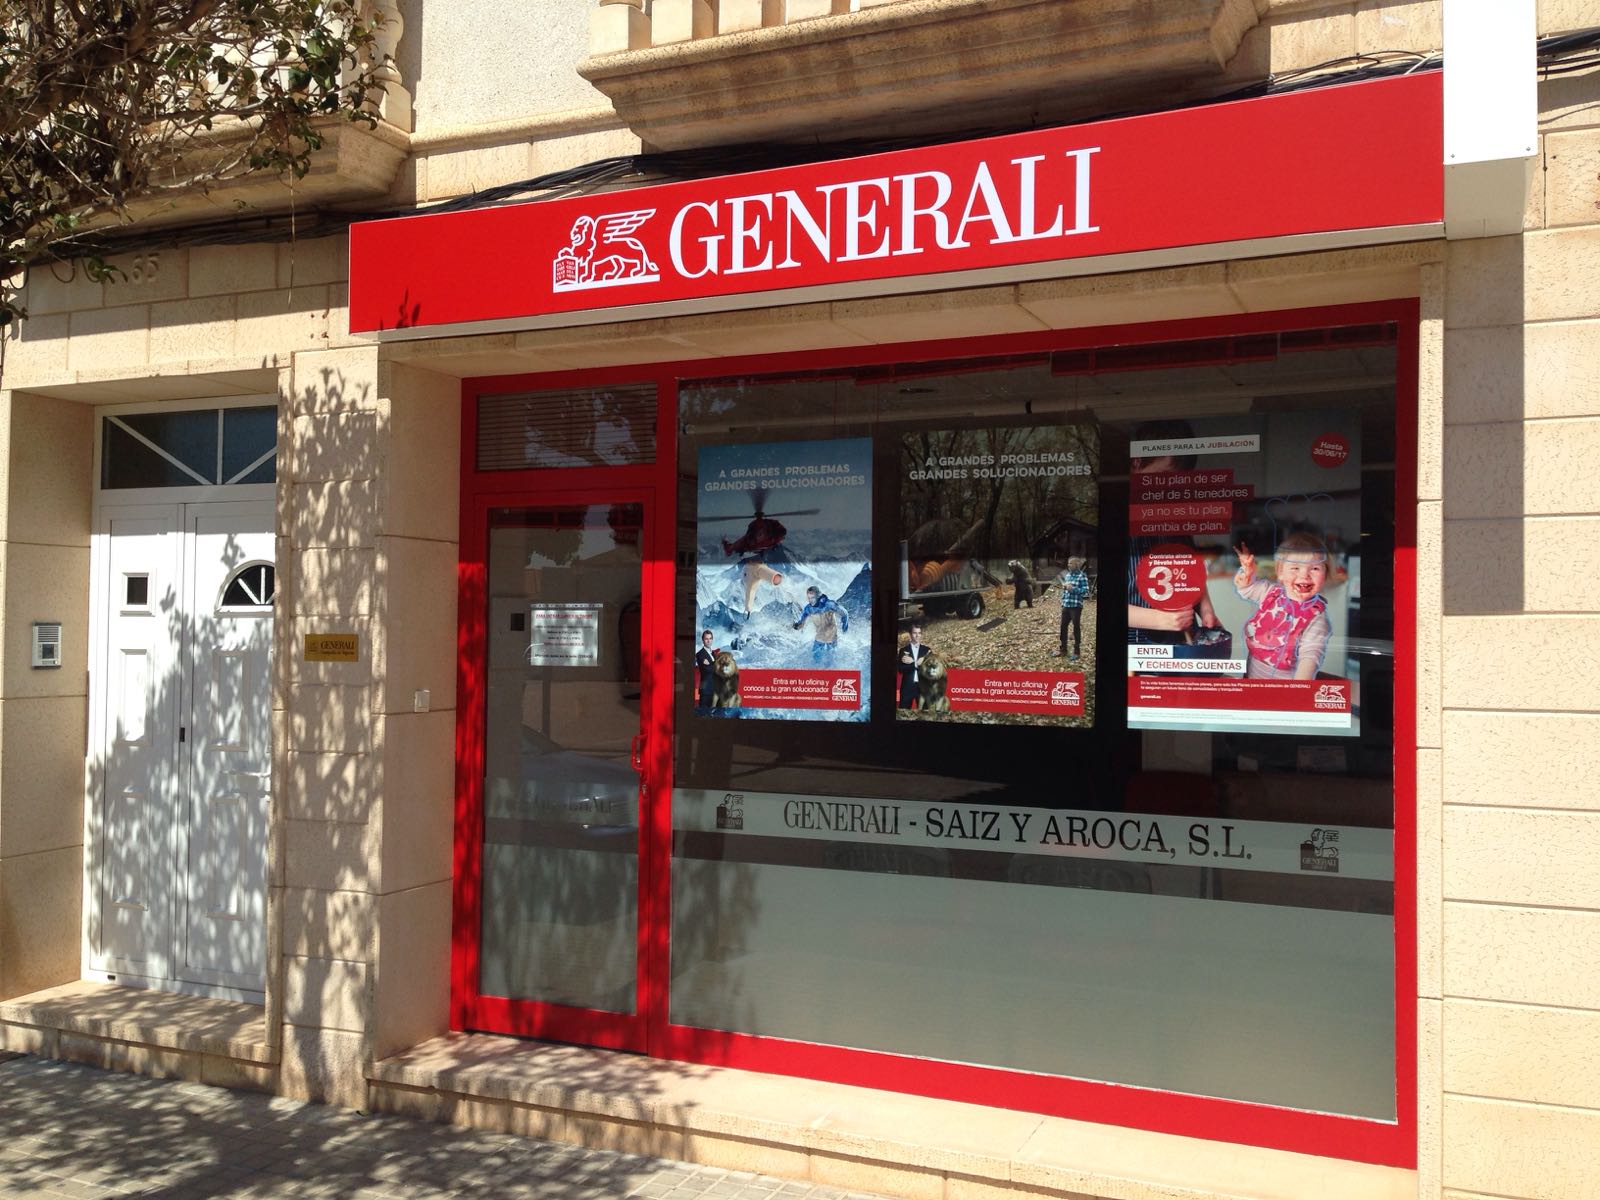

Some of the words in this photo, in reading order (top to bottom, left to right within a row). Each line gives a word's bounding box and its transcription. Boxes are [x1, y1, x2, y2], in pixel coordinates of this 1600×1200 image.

[669, 146, 1101, 278] GENERALI
[1142, 444, 1171, 452] PLANES
[1207, 440, 1255, 448] JUBILACIÓN
[1321, 441, 1343, 450] Hasta
[925, 457, 934, 466] A
[939, 455, 995, 466] GRANDES
[1001, 452, 1074, 464] PROBLEMAS
[719, 470, 726, 478] A
[730, 467, 780, 478] GRANDES
[785, 464, 850, 476] PROBLEMAS
[909, 469, 968, 480] GRANDES
[973, 465, 1091, 479] SOLUCIONADORES
[705, 480, 757, 492] GRANDES
[761, 475, 865, 489] SOLUCIONADORES
[1142, 475, 1152, 485] Si
[1155, 476, 1165, 485] tu
[1168, 474, 1191, 487] plan
[1194, 474, 1208, 483] de
[1210, 474, 1227, 483] ser
[1142, 490, 1164, 500] chef
[1167, 490, 1181, 500] de
[1183, 489, 1191, 499] 5
[1194, 488, 1249, 498] tenedores
[1141, 508, 1154, 518] ya
[1156, 507, 1171, 516] no
[1173, 507, 1186, 516] es
[1189, 505, 1200, 515] tu
[1202, 504, 1228, 516] plan.
[1141, 522, 1180, 532] cambia
[1183, 521, 1197, 531] de
[1200, 520, 1226, 532] plan.
[320, 640, 355, 650] GENERALI
[1137, 647, 1169, 655] ENTRA
[1138, 661, 1144, 669] Y
[1146, 661, 1194, 670] ECHEMOS
[1196, 662, 1242, 671] CUENTAS
[1006, 688, 1048, 696] solucionador
[783, 800, 902, 835] GENERALI
[926, 808, 1001, 842] SAIZ
[1009, 813, 1033, 843] Y
[1040, 815, 1177, 859] AROCA,
[1188, 824, 1253, 860] S.L.
